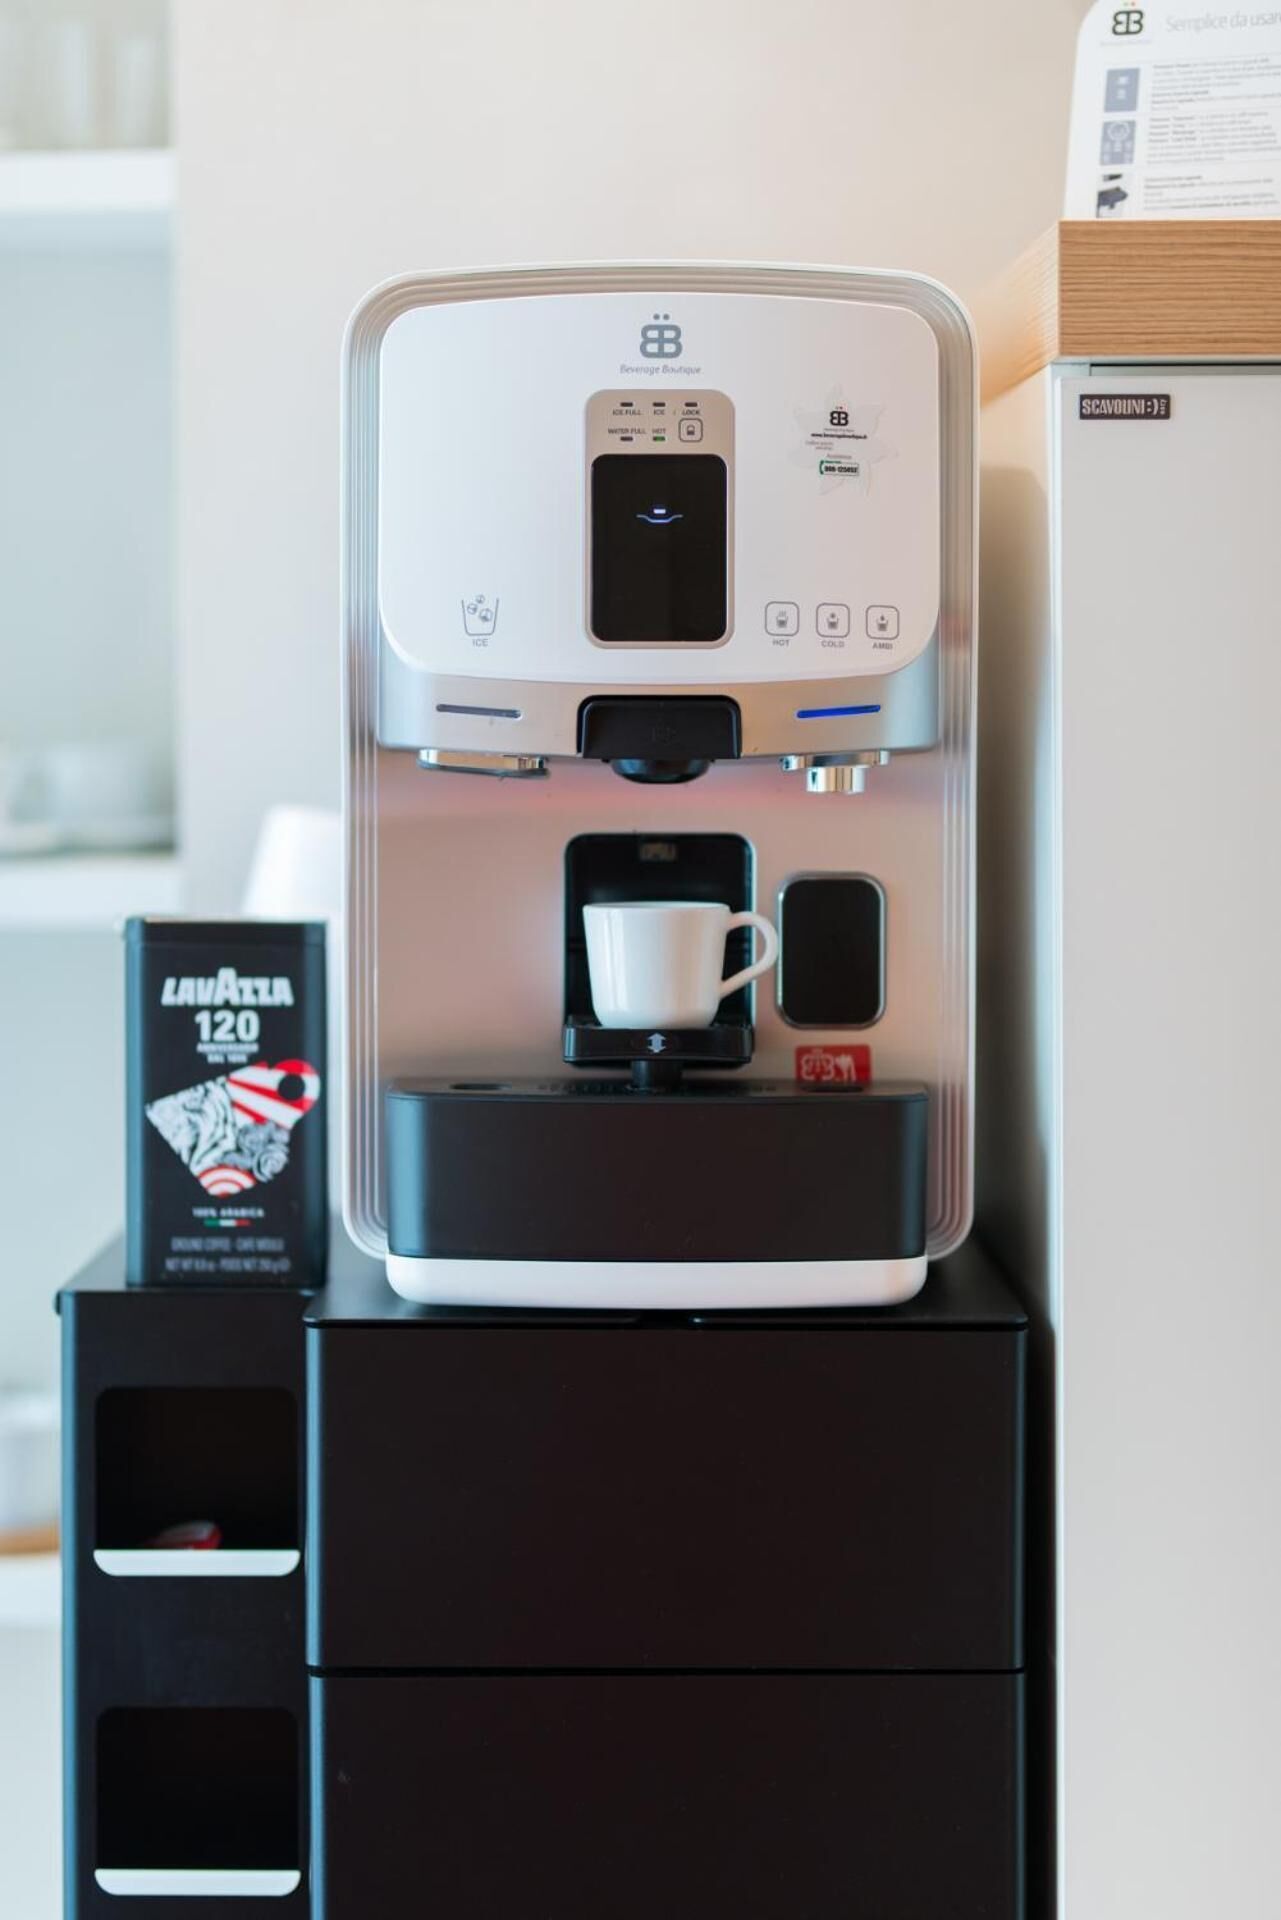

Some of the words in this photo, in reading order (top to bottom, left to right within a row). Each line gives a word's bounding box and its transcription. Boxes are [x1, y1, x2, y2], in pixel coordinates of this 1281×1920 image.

[1166, 14, 1226, 33] Semplice
[1230, 12, 1247, 27] da
[1250, 11, 1281, 26] usar
[472, 638, 489, 647] ICE
[772, 639, 790, 647] HOT
[821, 640, 845, 648] COLD
[872, 642, 893, 650] AMBI
[161, 966, 295, 1007] LAVAZZA
[194, 1009, 260, 1042] 120
